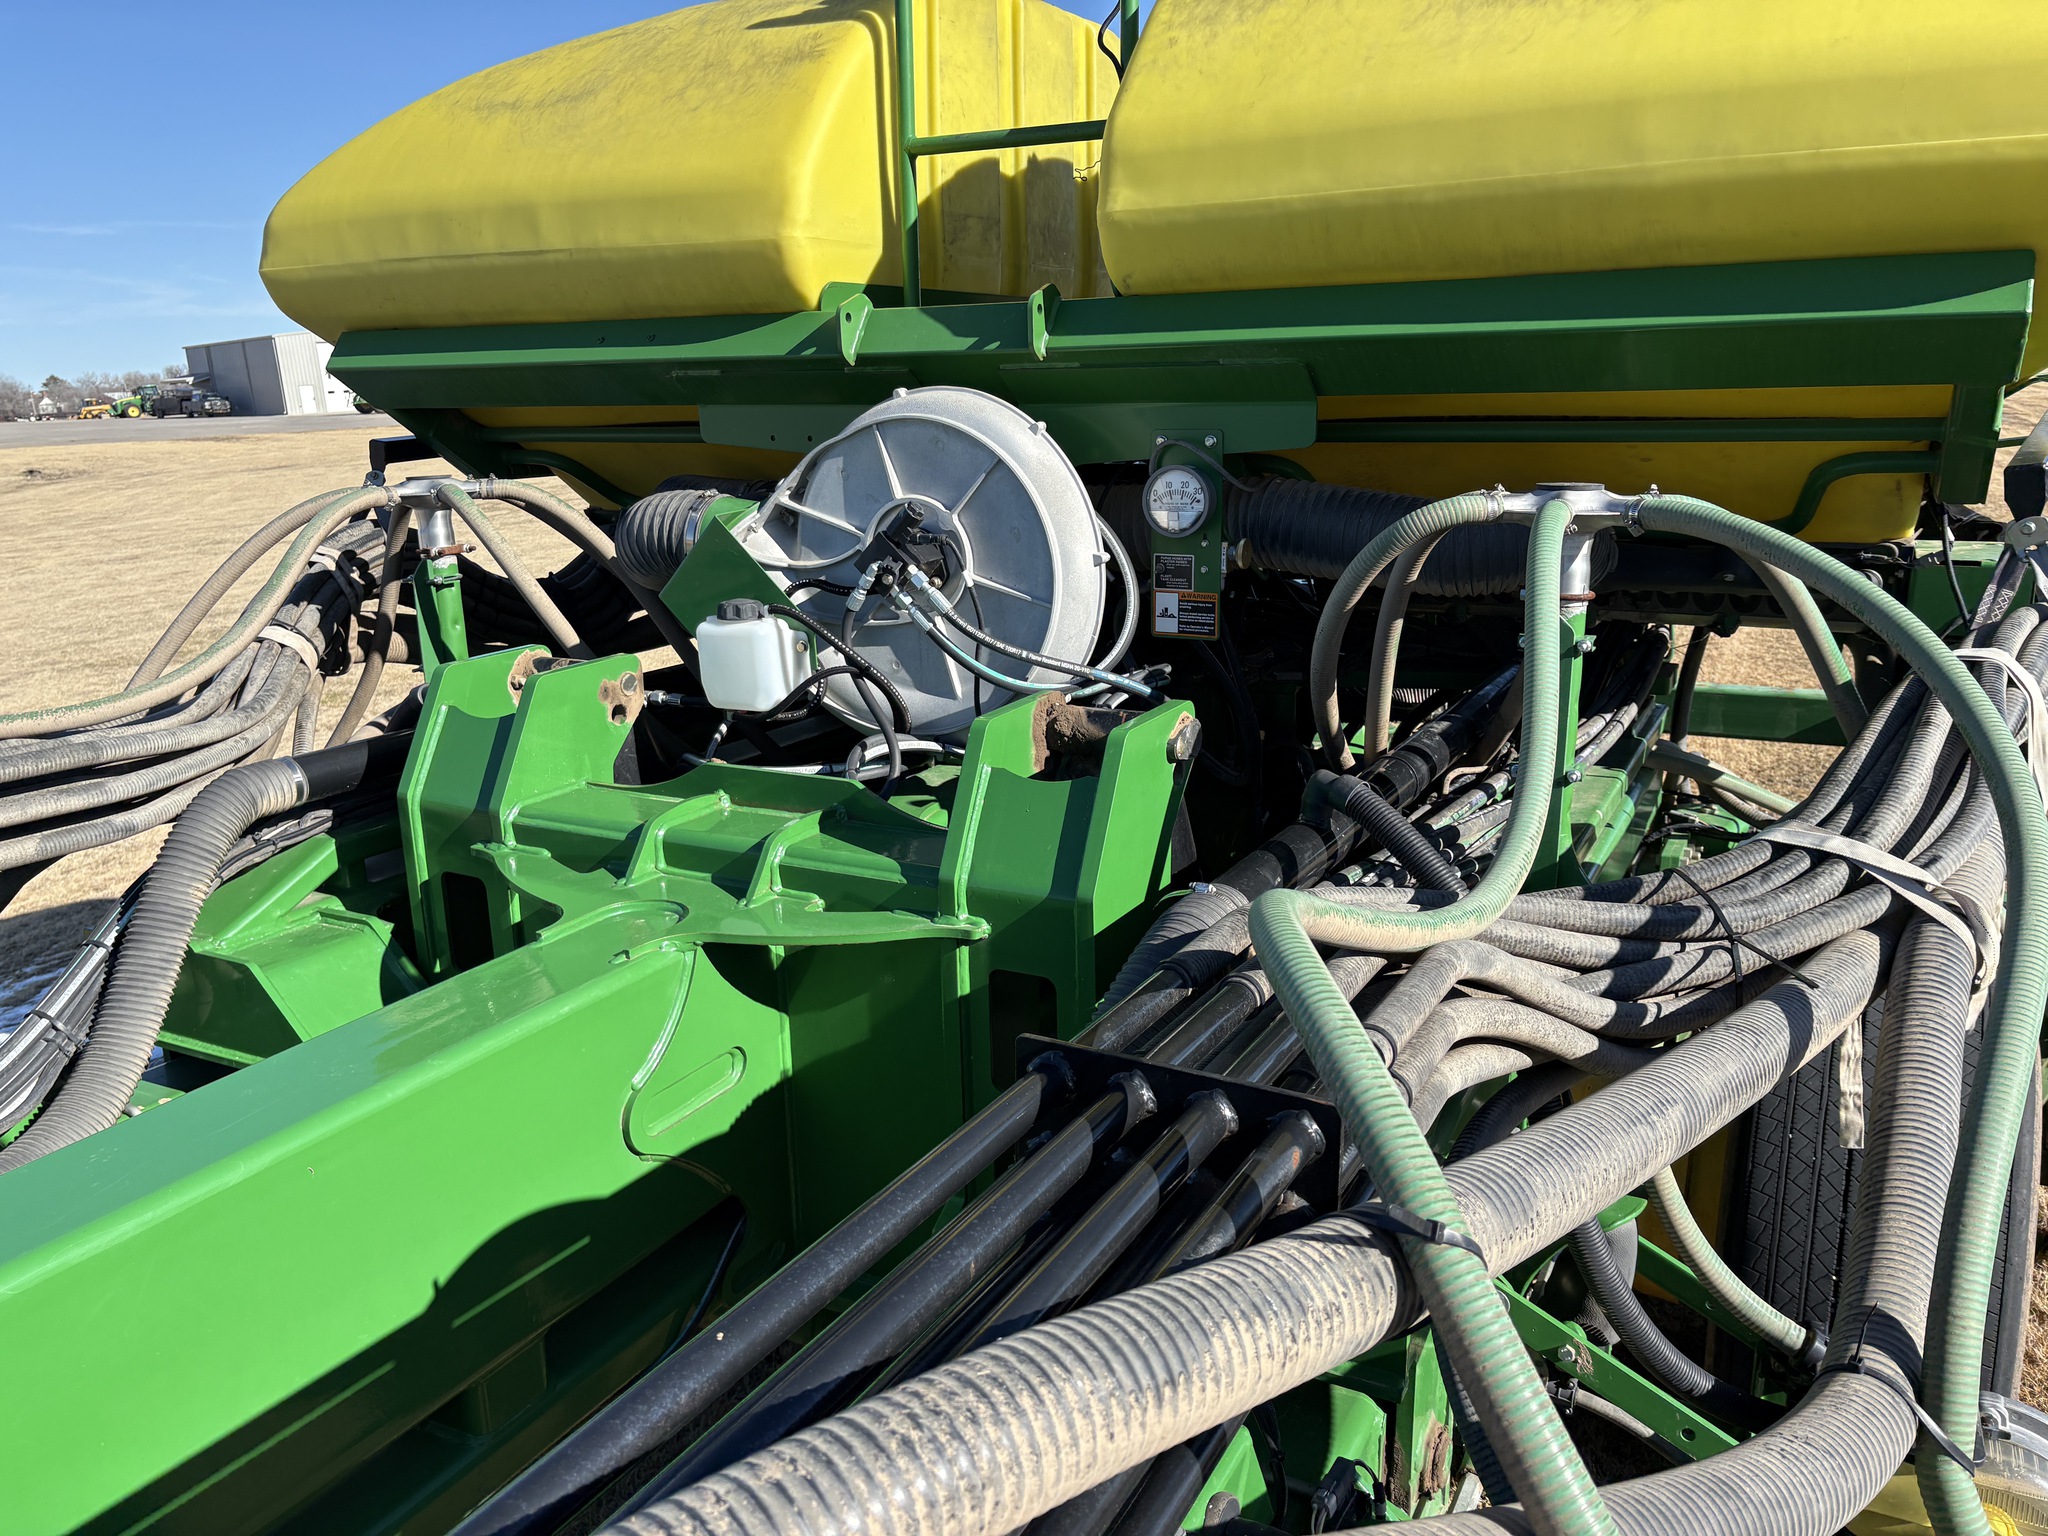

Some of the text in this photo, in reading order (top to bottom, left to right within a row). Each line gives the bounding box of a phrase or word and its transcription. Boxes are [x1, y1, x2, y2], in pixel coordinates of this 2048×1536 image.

[1165, 481, 1190, 489] 10 20
[1153, 489, 1158, 497] 0
[1193, 488, 1203, 496] 30
